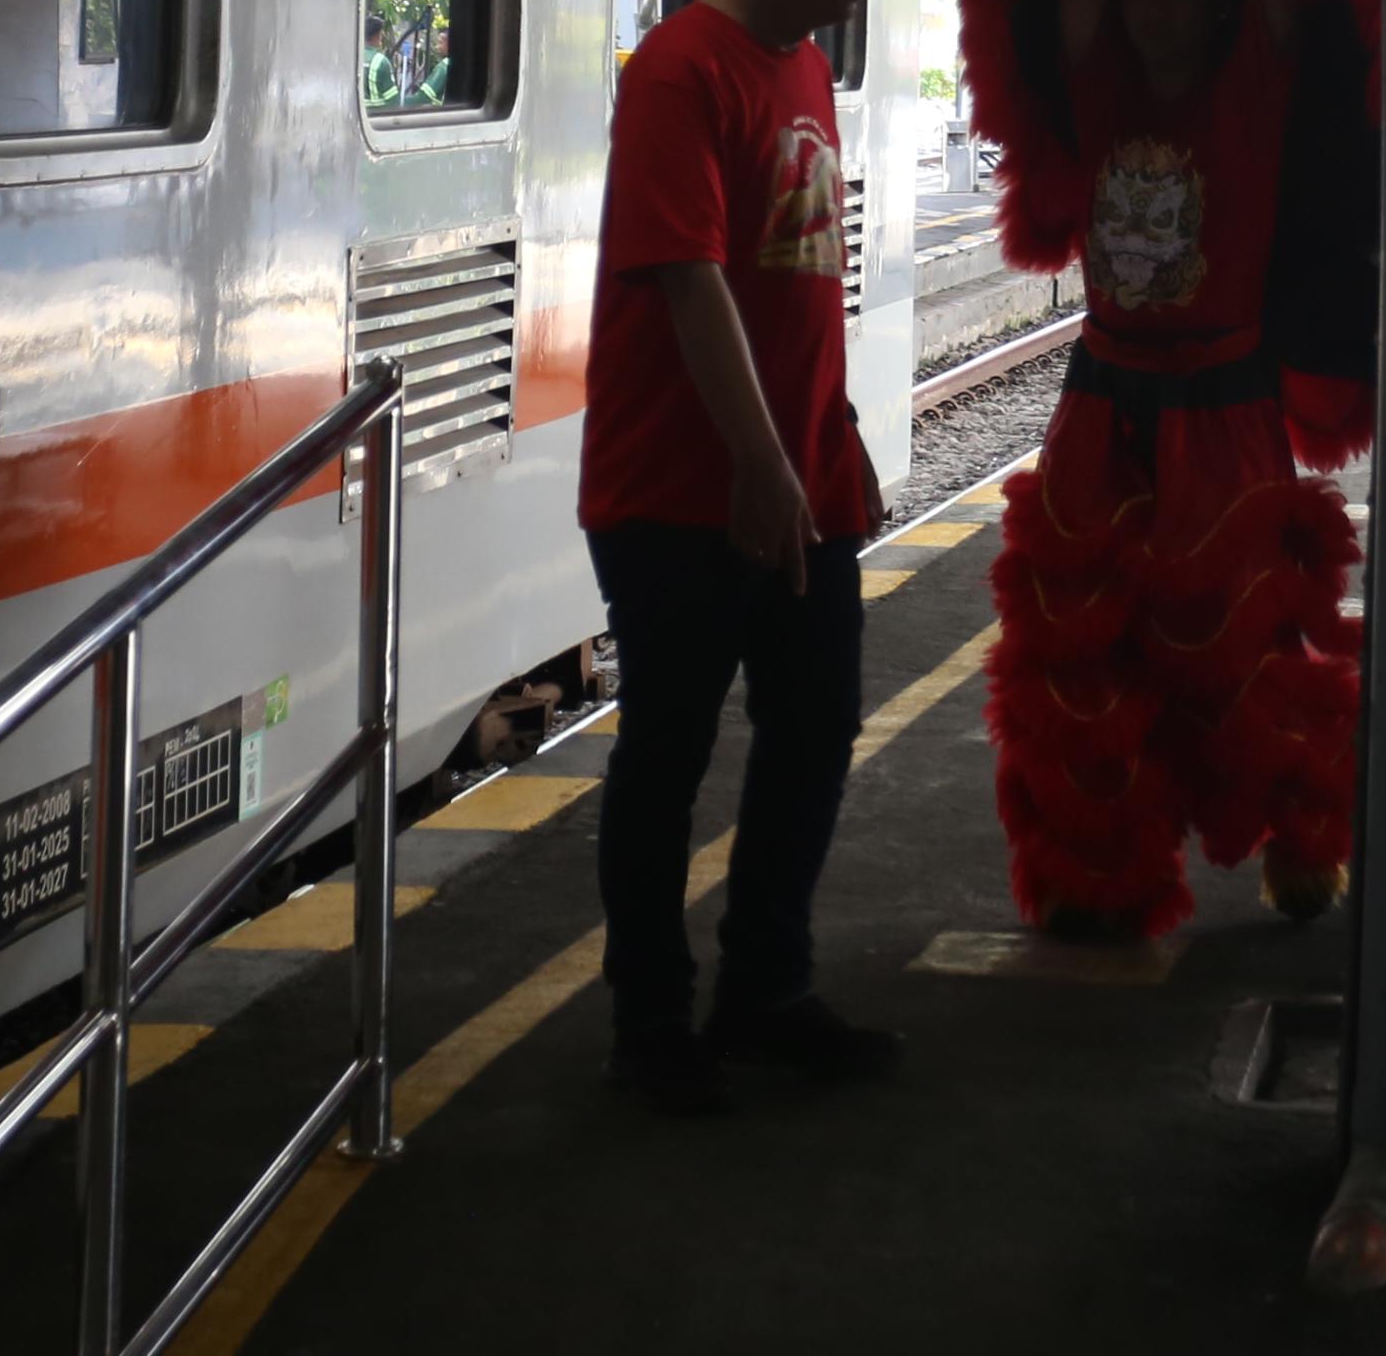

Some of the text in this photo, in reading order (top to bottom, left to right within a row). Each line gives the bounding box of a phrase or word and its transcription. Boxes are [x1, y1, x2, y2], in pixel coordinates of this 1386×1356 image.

[4, 789, 71, 843] 11-02-2008
[1, 826, 71, 882] 31-01-2025
[0, 861, 70, 921] 31-01-2027
